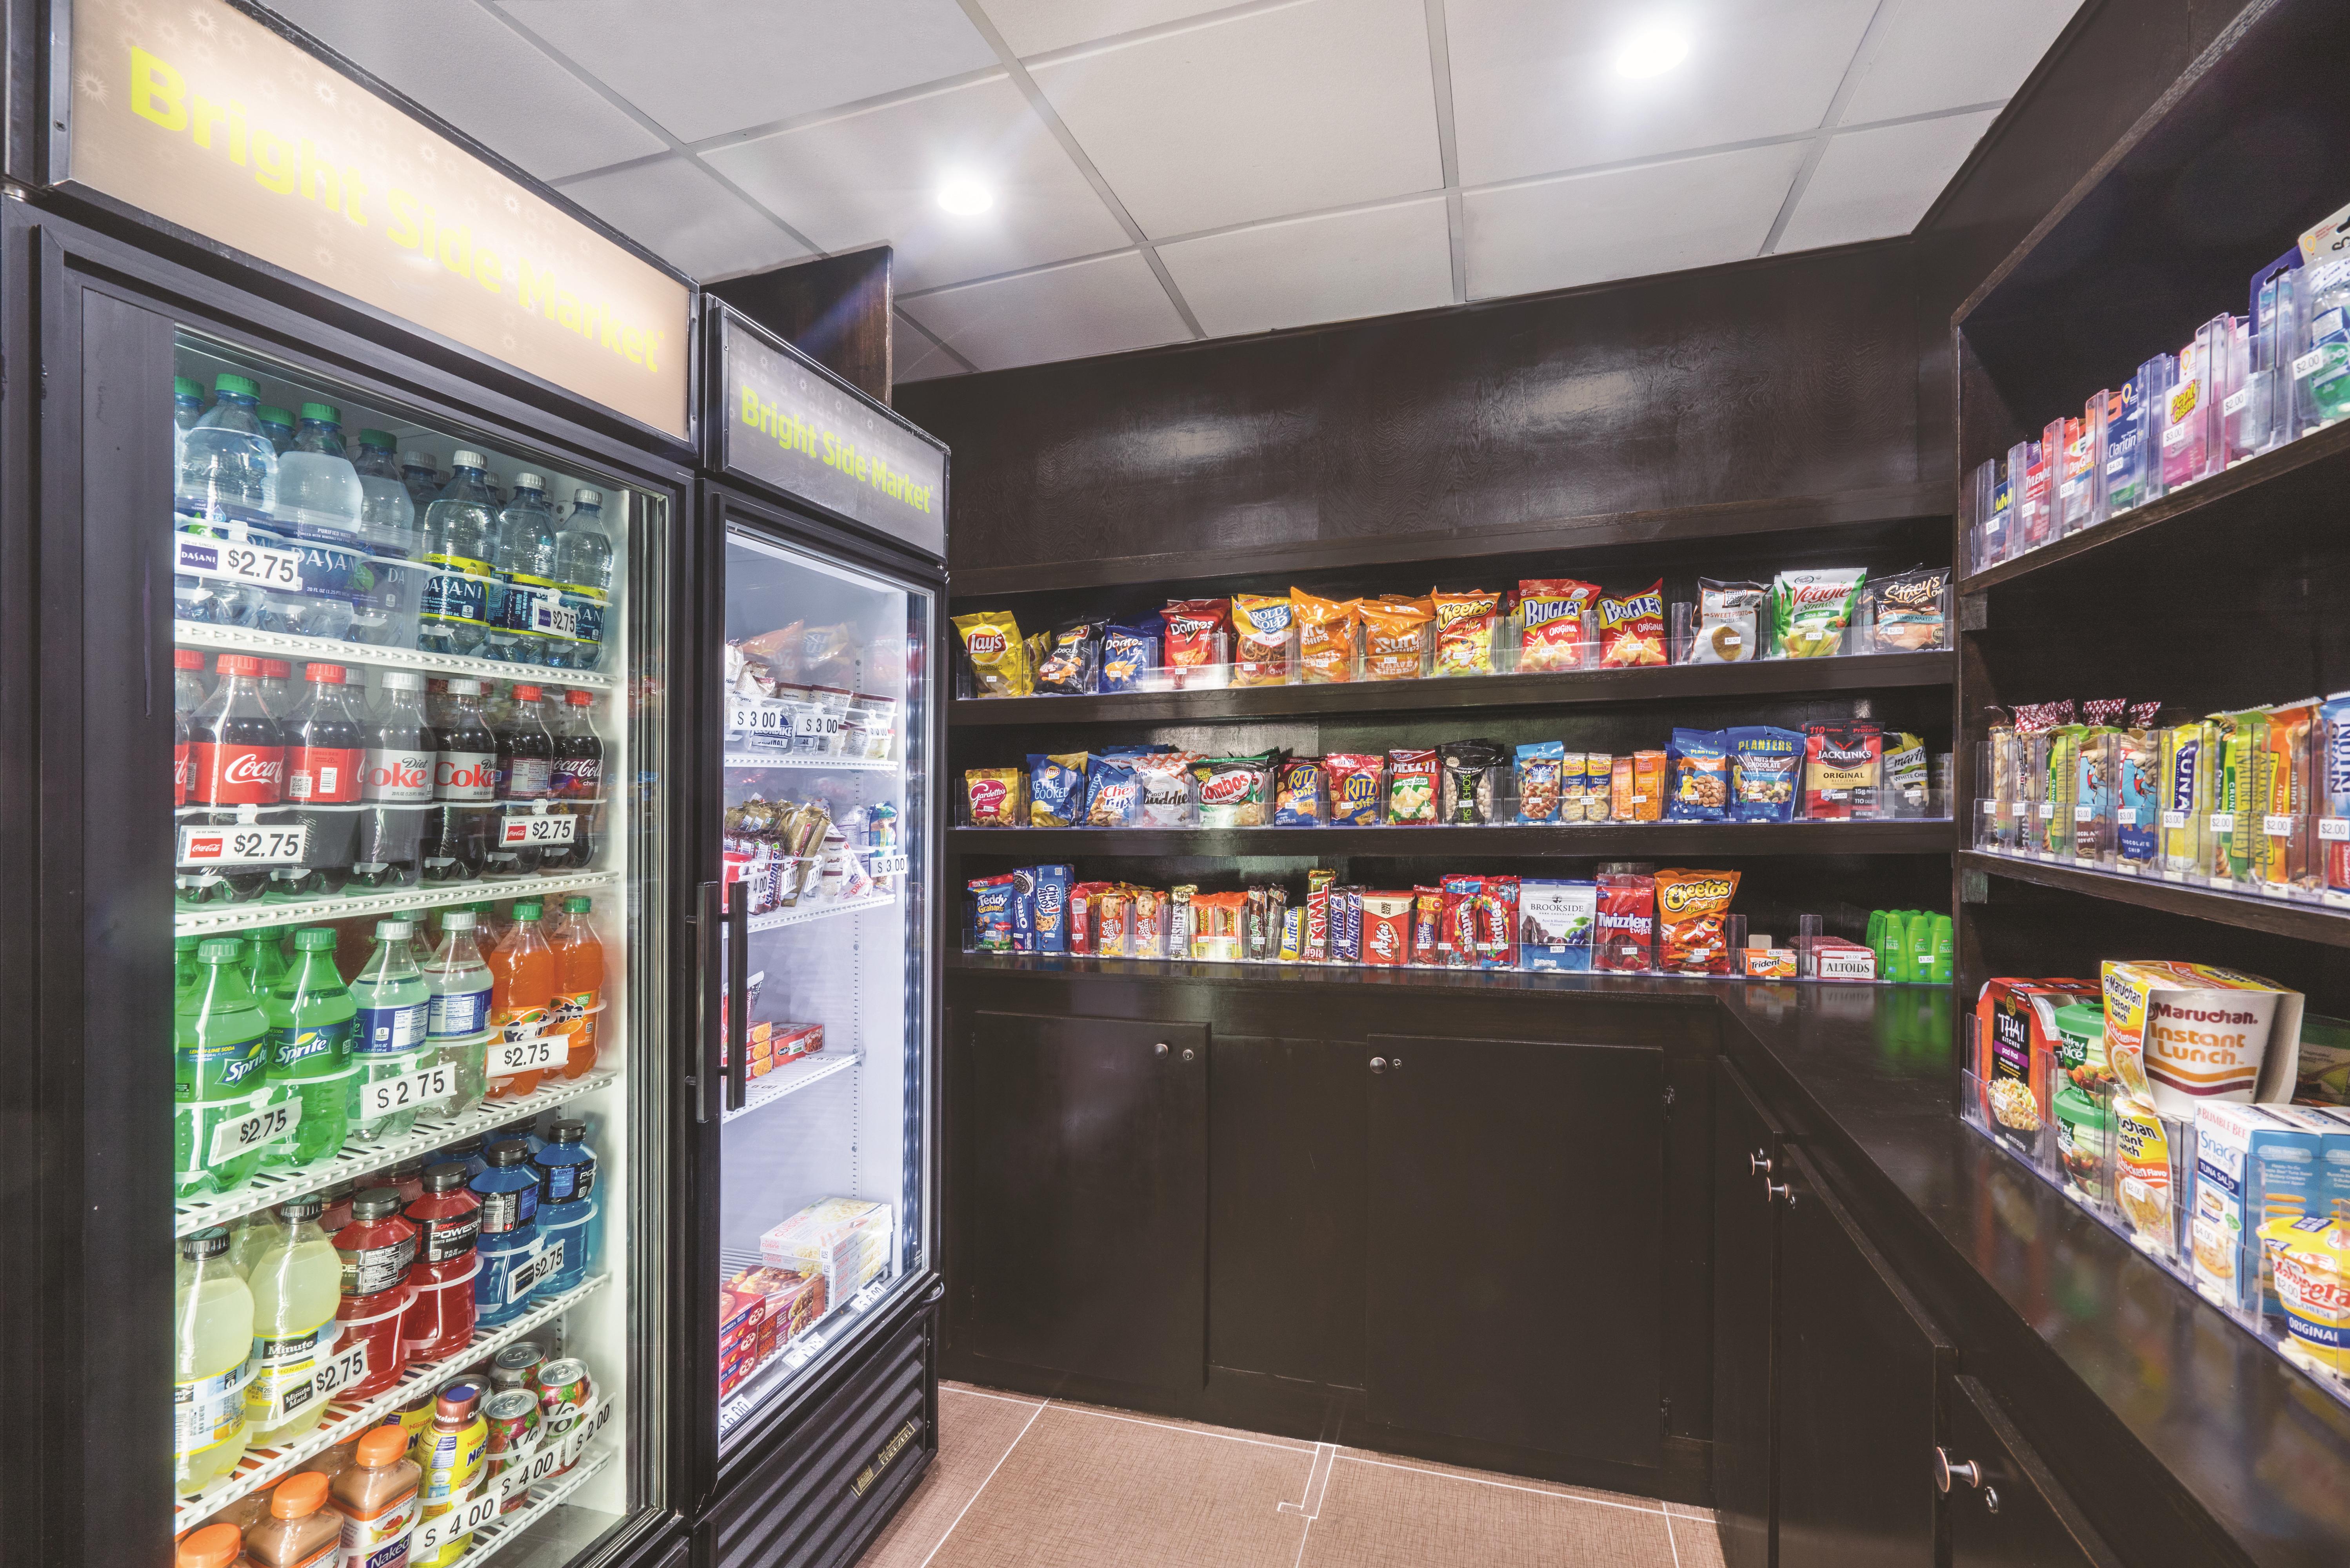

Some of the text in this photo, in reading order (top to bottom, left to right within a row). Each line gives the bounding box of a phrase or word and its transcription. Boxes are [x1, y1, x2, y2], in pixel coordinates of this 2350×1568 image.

[130, 45, 665, 373] Bright Side Market
[2296, 355, 2320, 374] $2.00
[2225, 394, 2244, 411] $2.00
[2166, 428, 2182, 442] $3.00
[742, 385, 933, 513] Bright Side Market
[1987, 522, 1997, 531] $3.00
[181, 551, 216, 564] DASANI
[228, 548, 294, 583] $2.75
[1790, 584, 1852, 607] Veggie
[1524, 600, 1581, 628] BUGLES
[1601, 596, 1663, 625] BUGLES
[553, 610, 574, 632] $2.75
[1549, 624, 1578, 635] ORIGINAL
[1637, 622, 1664, 633] ORIGINAL
[970, 633, 1003, 654] Lay's
[1738, 739, 1792, 752] PLANTERS
[402, 757, 427, 768] Diet
[1816, 750, 1872, 760] JACK LINK'S
[1045, 768, 1060, 778] Lay's
[1288, 767, 1318, 789] RITZ
[1403, 777, 1429, 786] cheddar
[1032, 779, 1060, 794] KETTLE
[1034, 788, 1069, 800] COOKED
[1345, 778, 1375, 800] RITZ
[2119, 812, 2134, 820] $3.00
[2165, 815, 2181, 824] $3.00
[2212, 818, 2230, 828] $2.00
[533, 820, 571, 839] $2.75
[2266, 820, 2287, 831] $2.00
[2321, 823, 2346, 835] $2.00
[234, 833, 299, 857] $2.75
[978, 894, 1008, 906] Teddy
[978, 904, 1005, 913] Grahams
[1530, 903, 1584, 913] BROOKSIDE
[1019, 897, 1029, 929] OREO
[1750, 958, 1781, 969] Trident
[1826, 962, 1870, 973] ALTOIDS
[2110, 995, 2131, 1014] Instant
[2156, 1002, 2258, 1024] Maruchan
[2112, 1007, 2128, 1025] Lunch
[1998, 1013, 2025, 1043] THAI
[2151, 1022, 2246, 1048] Instant
[275, 1038, 327, 1063] Sprite
[2003, 1036, 2020, 1049] KITCHEN
[504, 1043, 550, 1067] $2.75
[2157, 1040, 2236, 1065] Lunch
[240, 1109, 287, 1144] $2.75
[2202, 1108, 2247, 1139] BUMBLE BEE
[2199, 1161, 2216, 1178] TUNA
[535, 1247, 562, 1278] $2.75
[316, 1351, 363, 1392] $2.75
[286, 1386, 310, 1403] Minute
[289, 1394, 307, 1408] Maid
[880, 1430, 911, 1465] FREEZER
